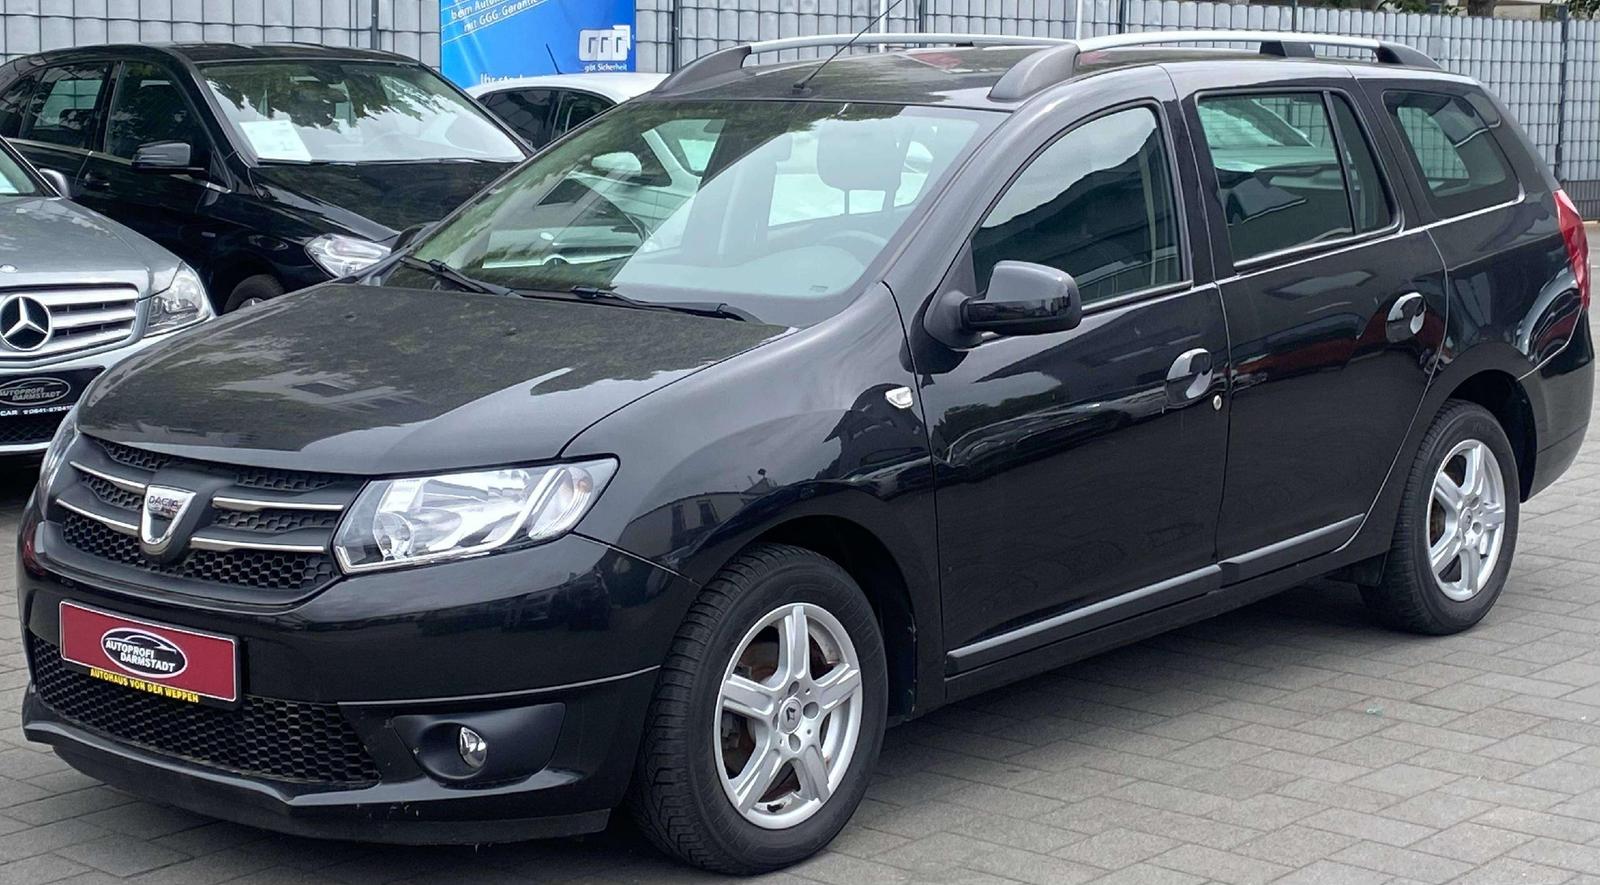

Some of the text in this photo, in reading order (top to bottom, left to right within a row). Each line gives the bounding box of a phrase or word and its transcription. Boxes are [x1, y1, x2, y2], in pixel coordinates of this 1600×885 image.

[597, 63, 627, 71] Sicherheit
[12, 391, 61, 400] DARMSTADT
[148, 495, 178, 507] DACIA
[105, 640, 154, 658] AUTOPROFI
[120, 654, 175, 672] DARMSTADT
[90, 668, 199, 702] AUTOHAUS VON DER WEPPEN
